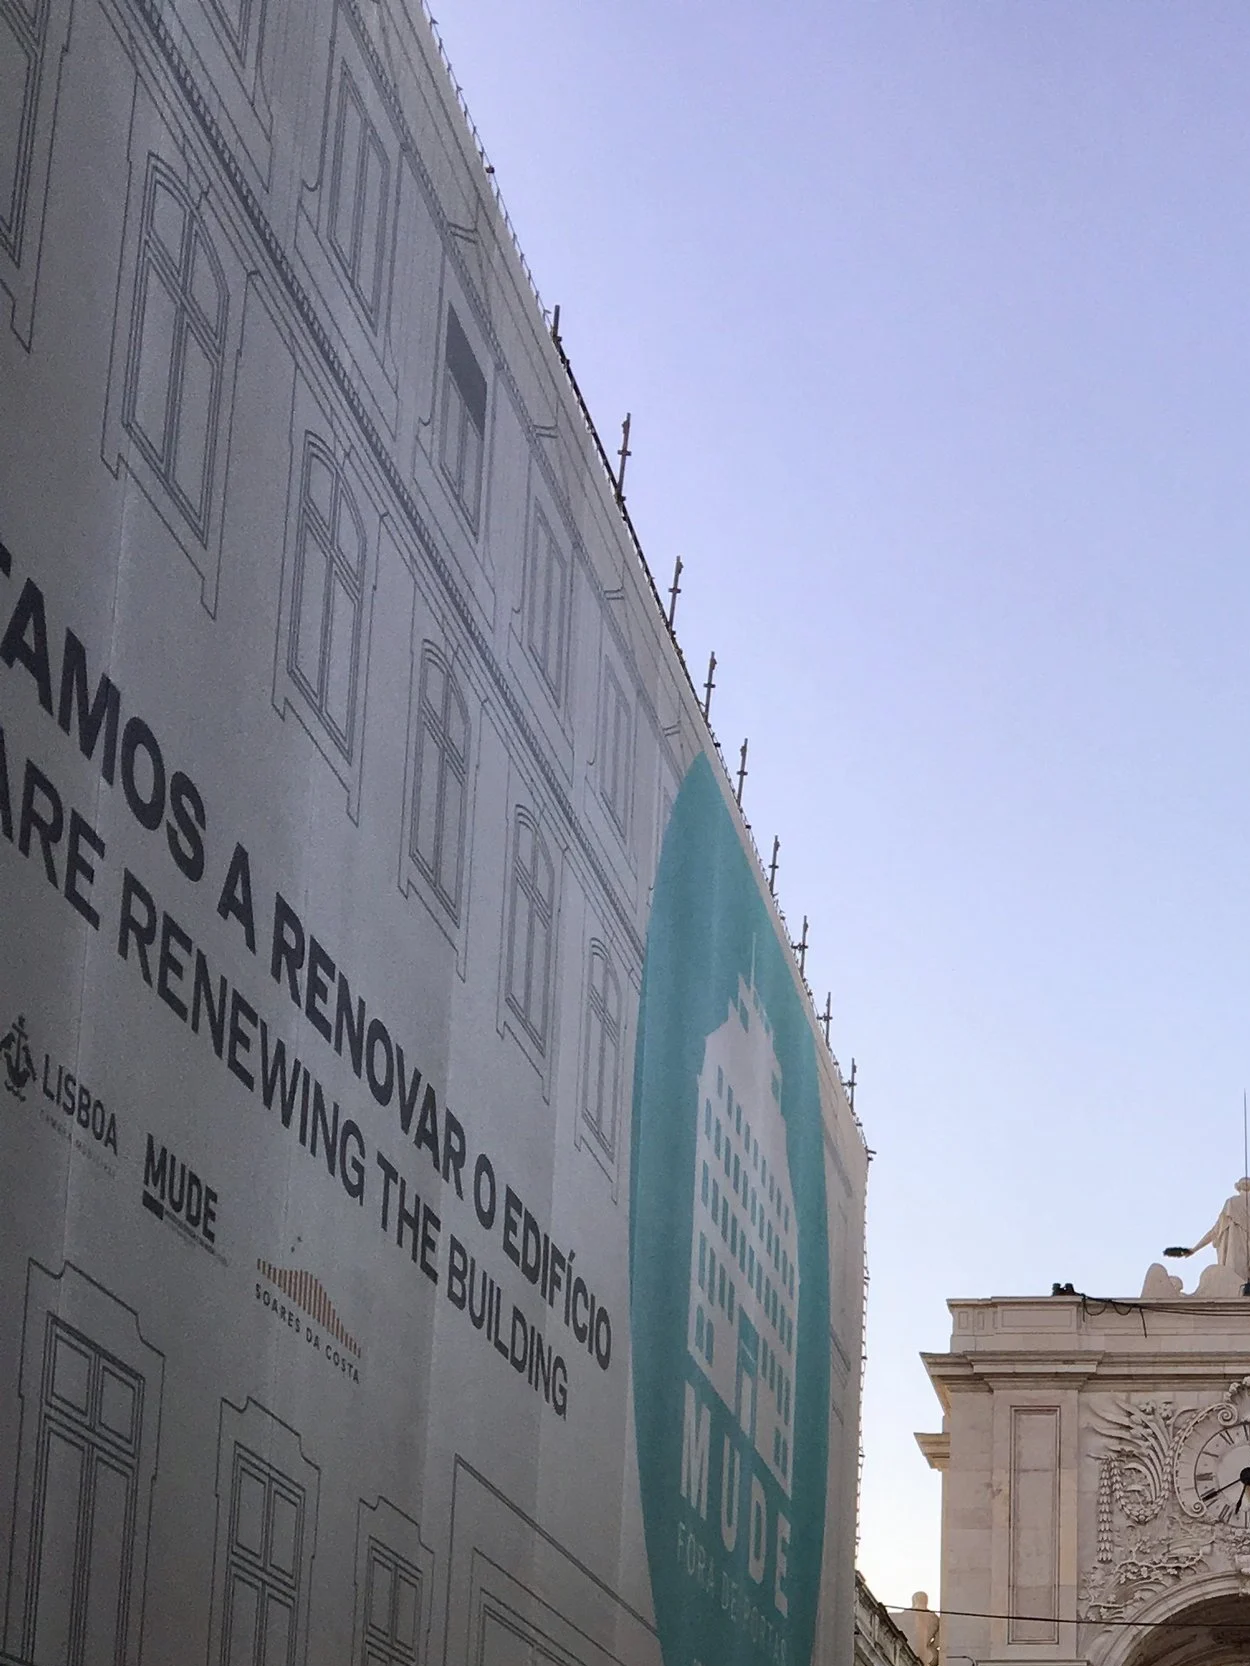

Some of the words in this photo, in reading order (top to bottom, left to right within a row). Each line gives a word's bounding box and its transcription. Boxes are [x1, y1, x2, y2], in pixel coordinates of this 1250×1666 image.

[0, 542, 207, 882] AMOS
[217, 841, 256, 955] A
[271, 892, 466, 1201] RENOVAR
[474, 1153, 496, 1230] O
[503, 1184, 612, 1371] EDIFÍCIO
[0, 727, 106, 931] RE
[118, 867, 366, 1206] RENEWING
[377, 1150, 442, 1286] THE
[447, 1233, 567, 1421] BUILDING
[42, 1053, 118, 1157] LISBOA
[144, 1132, 218, 1243] MUDE
[256, 1283, 301, 1333] SOARES
[306, 1327, 320, 1350] DA
[326, 1345, 360, 1385] COSTA
[680, 1380, 792, 1619] MUDE
